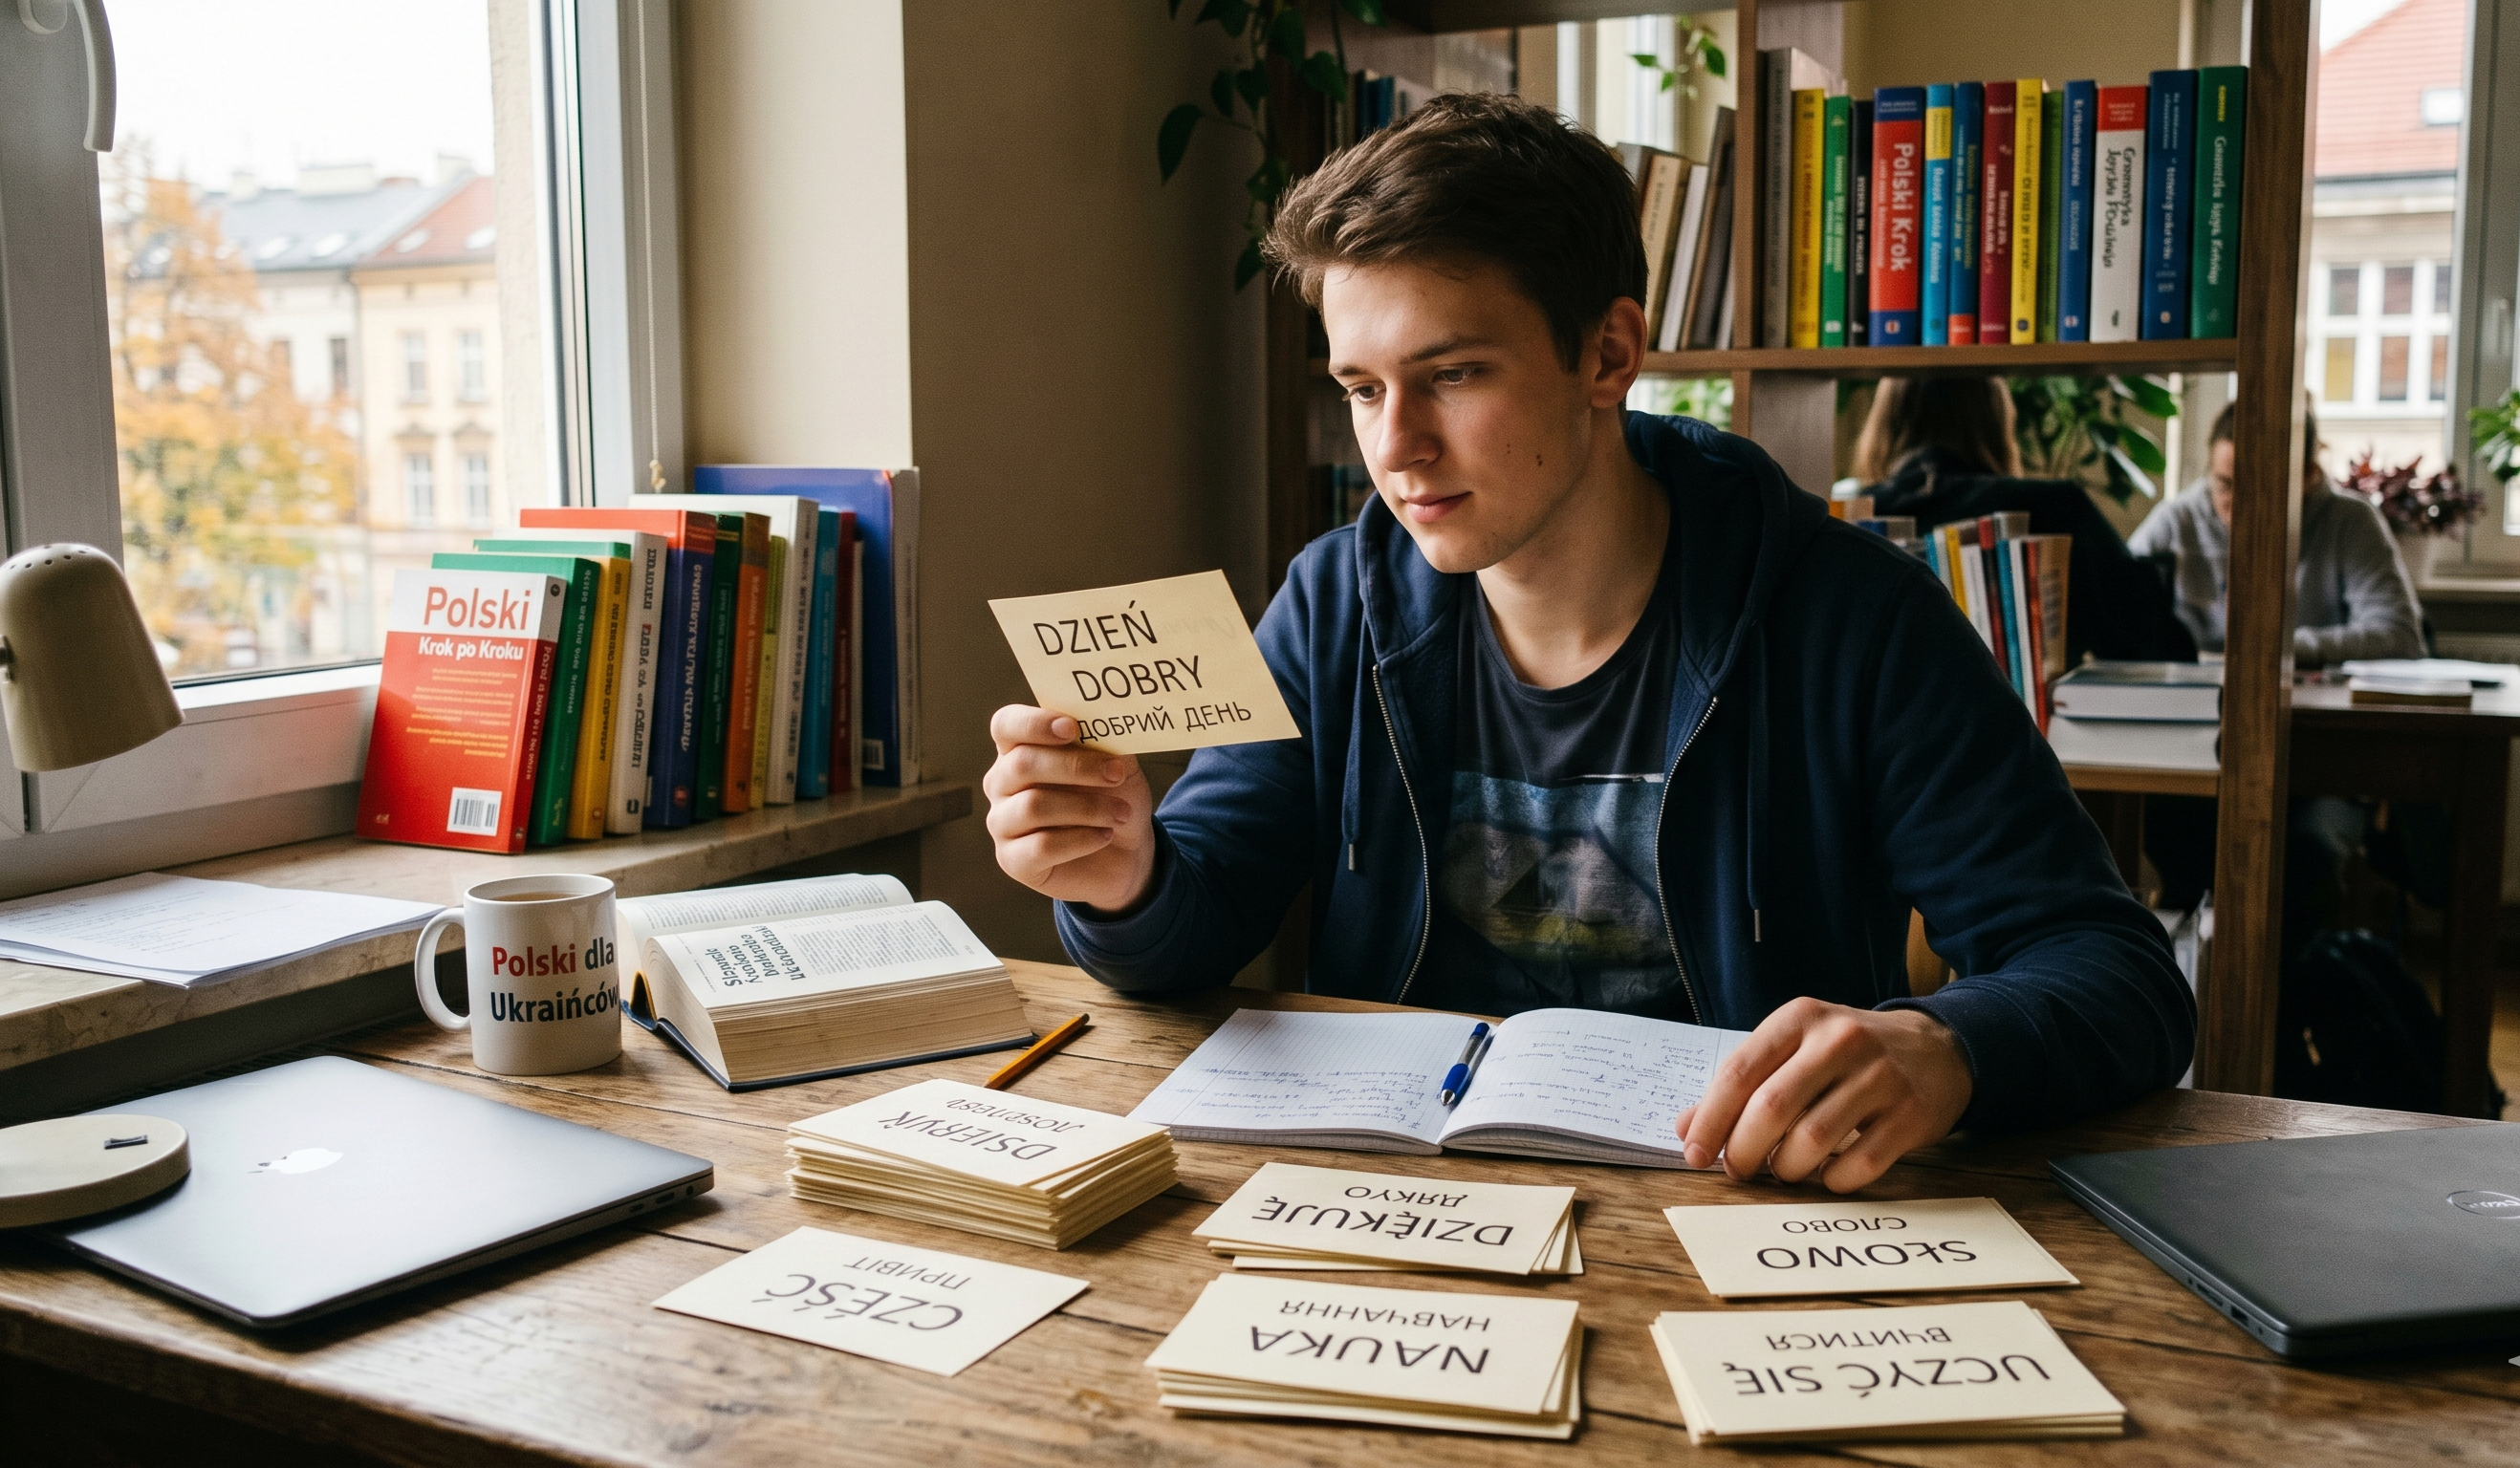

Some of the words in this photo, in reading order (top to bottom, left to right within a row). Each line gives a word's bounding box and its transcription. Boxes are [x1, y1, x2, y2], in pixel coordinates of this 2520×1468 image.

[1893, 142, 1915, 211] Polski
[1890, 217, 1913, 271] Krok
[424, 586, 532, 631] Polski
[1033, 599, 1158, 656] DZIEŃ
[418, 636, 455, 657] Krok
[478, 638, 525, 661] Kroku
[1072, 655, 1204, 702] DOBRY
[1077, 705, 1175, 744] ДОБРИЙ
[1184, 701, 1252, 733] ДЕНЬ
[492, 942, 576, 977] Polski
[584, 937, 615, 970] dla
[490, 981, 619, 1023] Ukraińców
[1781, 1217, 1908, 1234] СЛОВО
[842, 1256, 972, 1290] ПРИВІТ
[1755, 1241, 1978, 1270] SŁOWO
[1279, 1301, 1491, 1331] НАВЧАННЯ
[1250, 1326, 1490, 1374] NAUKA
[1766, 1327, 1953, 1351] ВЧИТИСЯ
[1721, 1362, 1823, 1396] SIĘ
[1836, 1353, 2052, 1398] UCZYĆ
